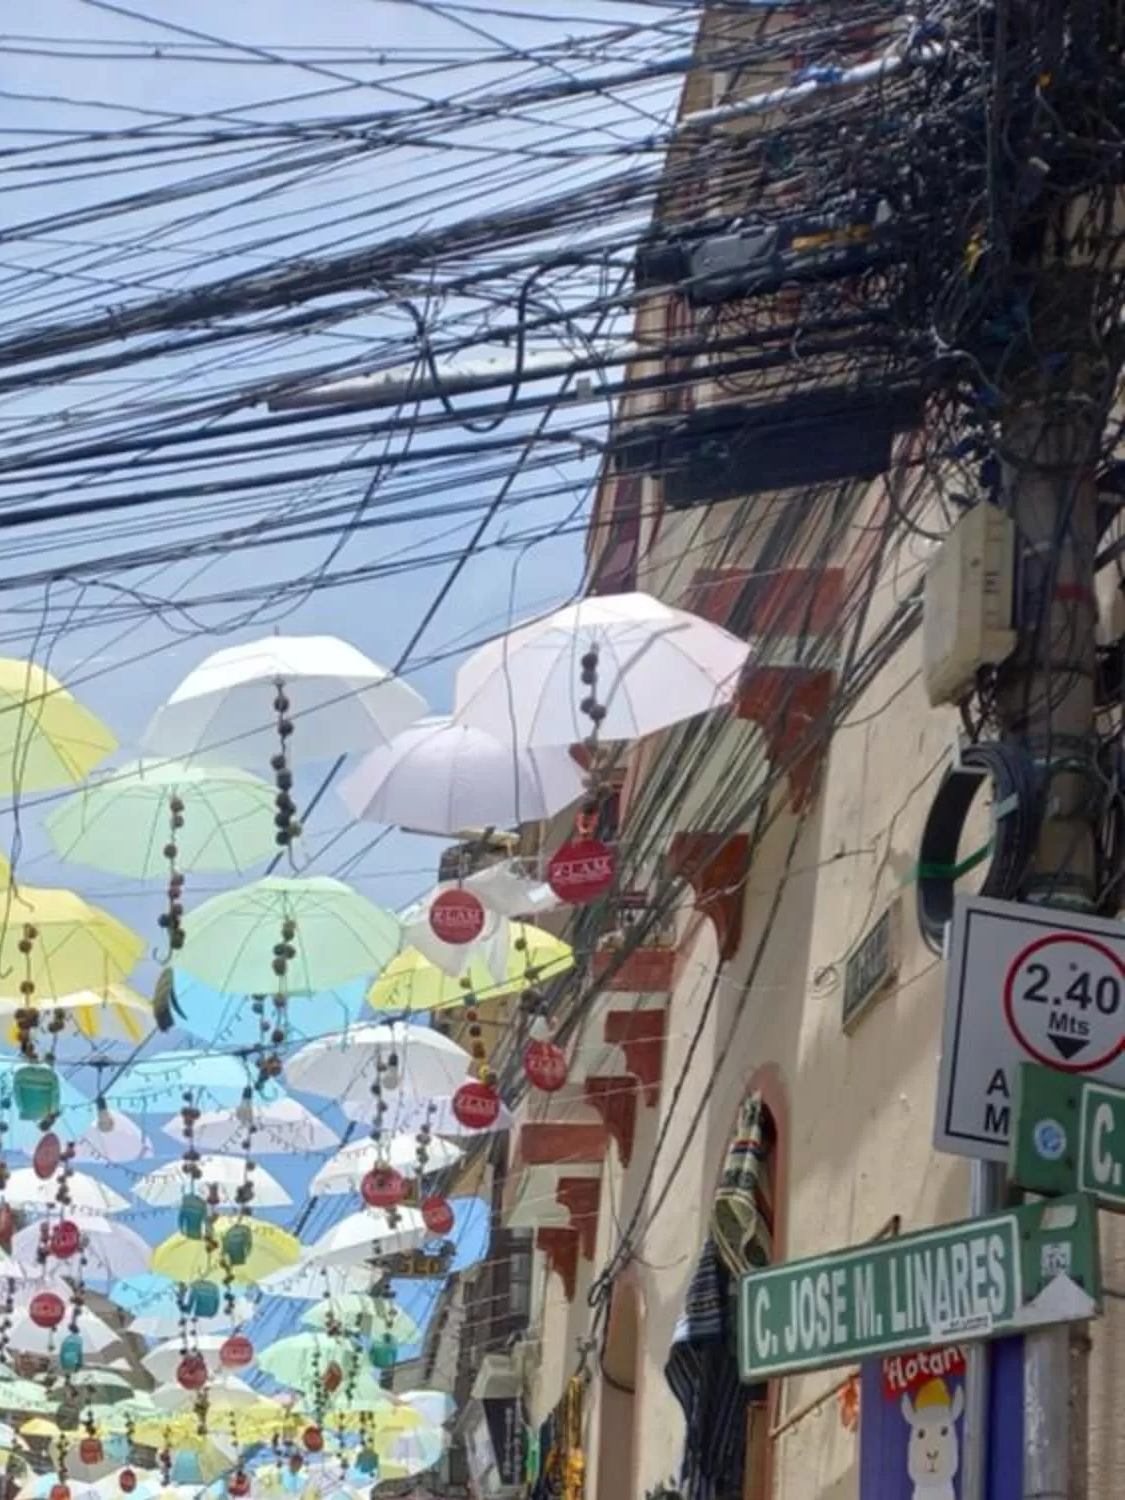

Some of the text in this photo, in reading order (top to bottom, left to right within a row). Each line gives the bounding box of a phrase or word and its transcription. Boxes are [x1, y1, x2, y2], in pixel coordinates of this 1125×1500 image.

[1022, 962, 1121, 1015] 2.40
[1048, 1010, 1091, 1036] Mts
[986, 1067, 1011, 1099] A
[983, 1103, 1011, 1137] M
[1091, 1102, 1122, 1186] C.
[754, 1233, 1006, 1358] C. JOSE M. LINARES
